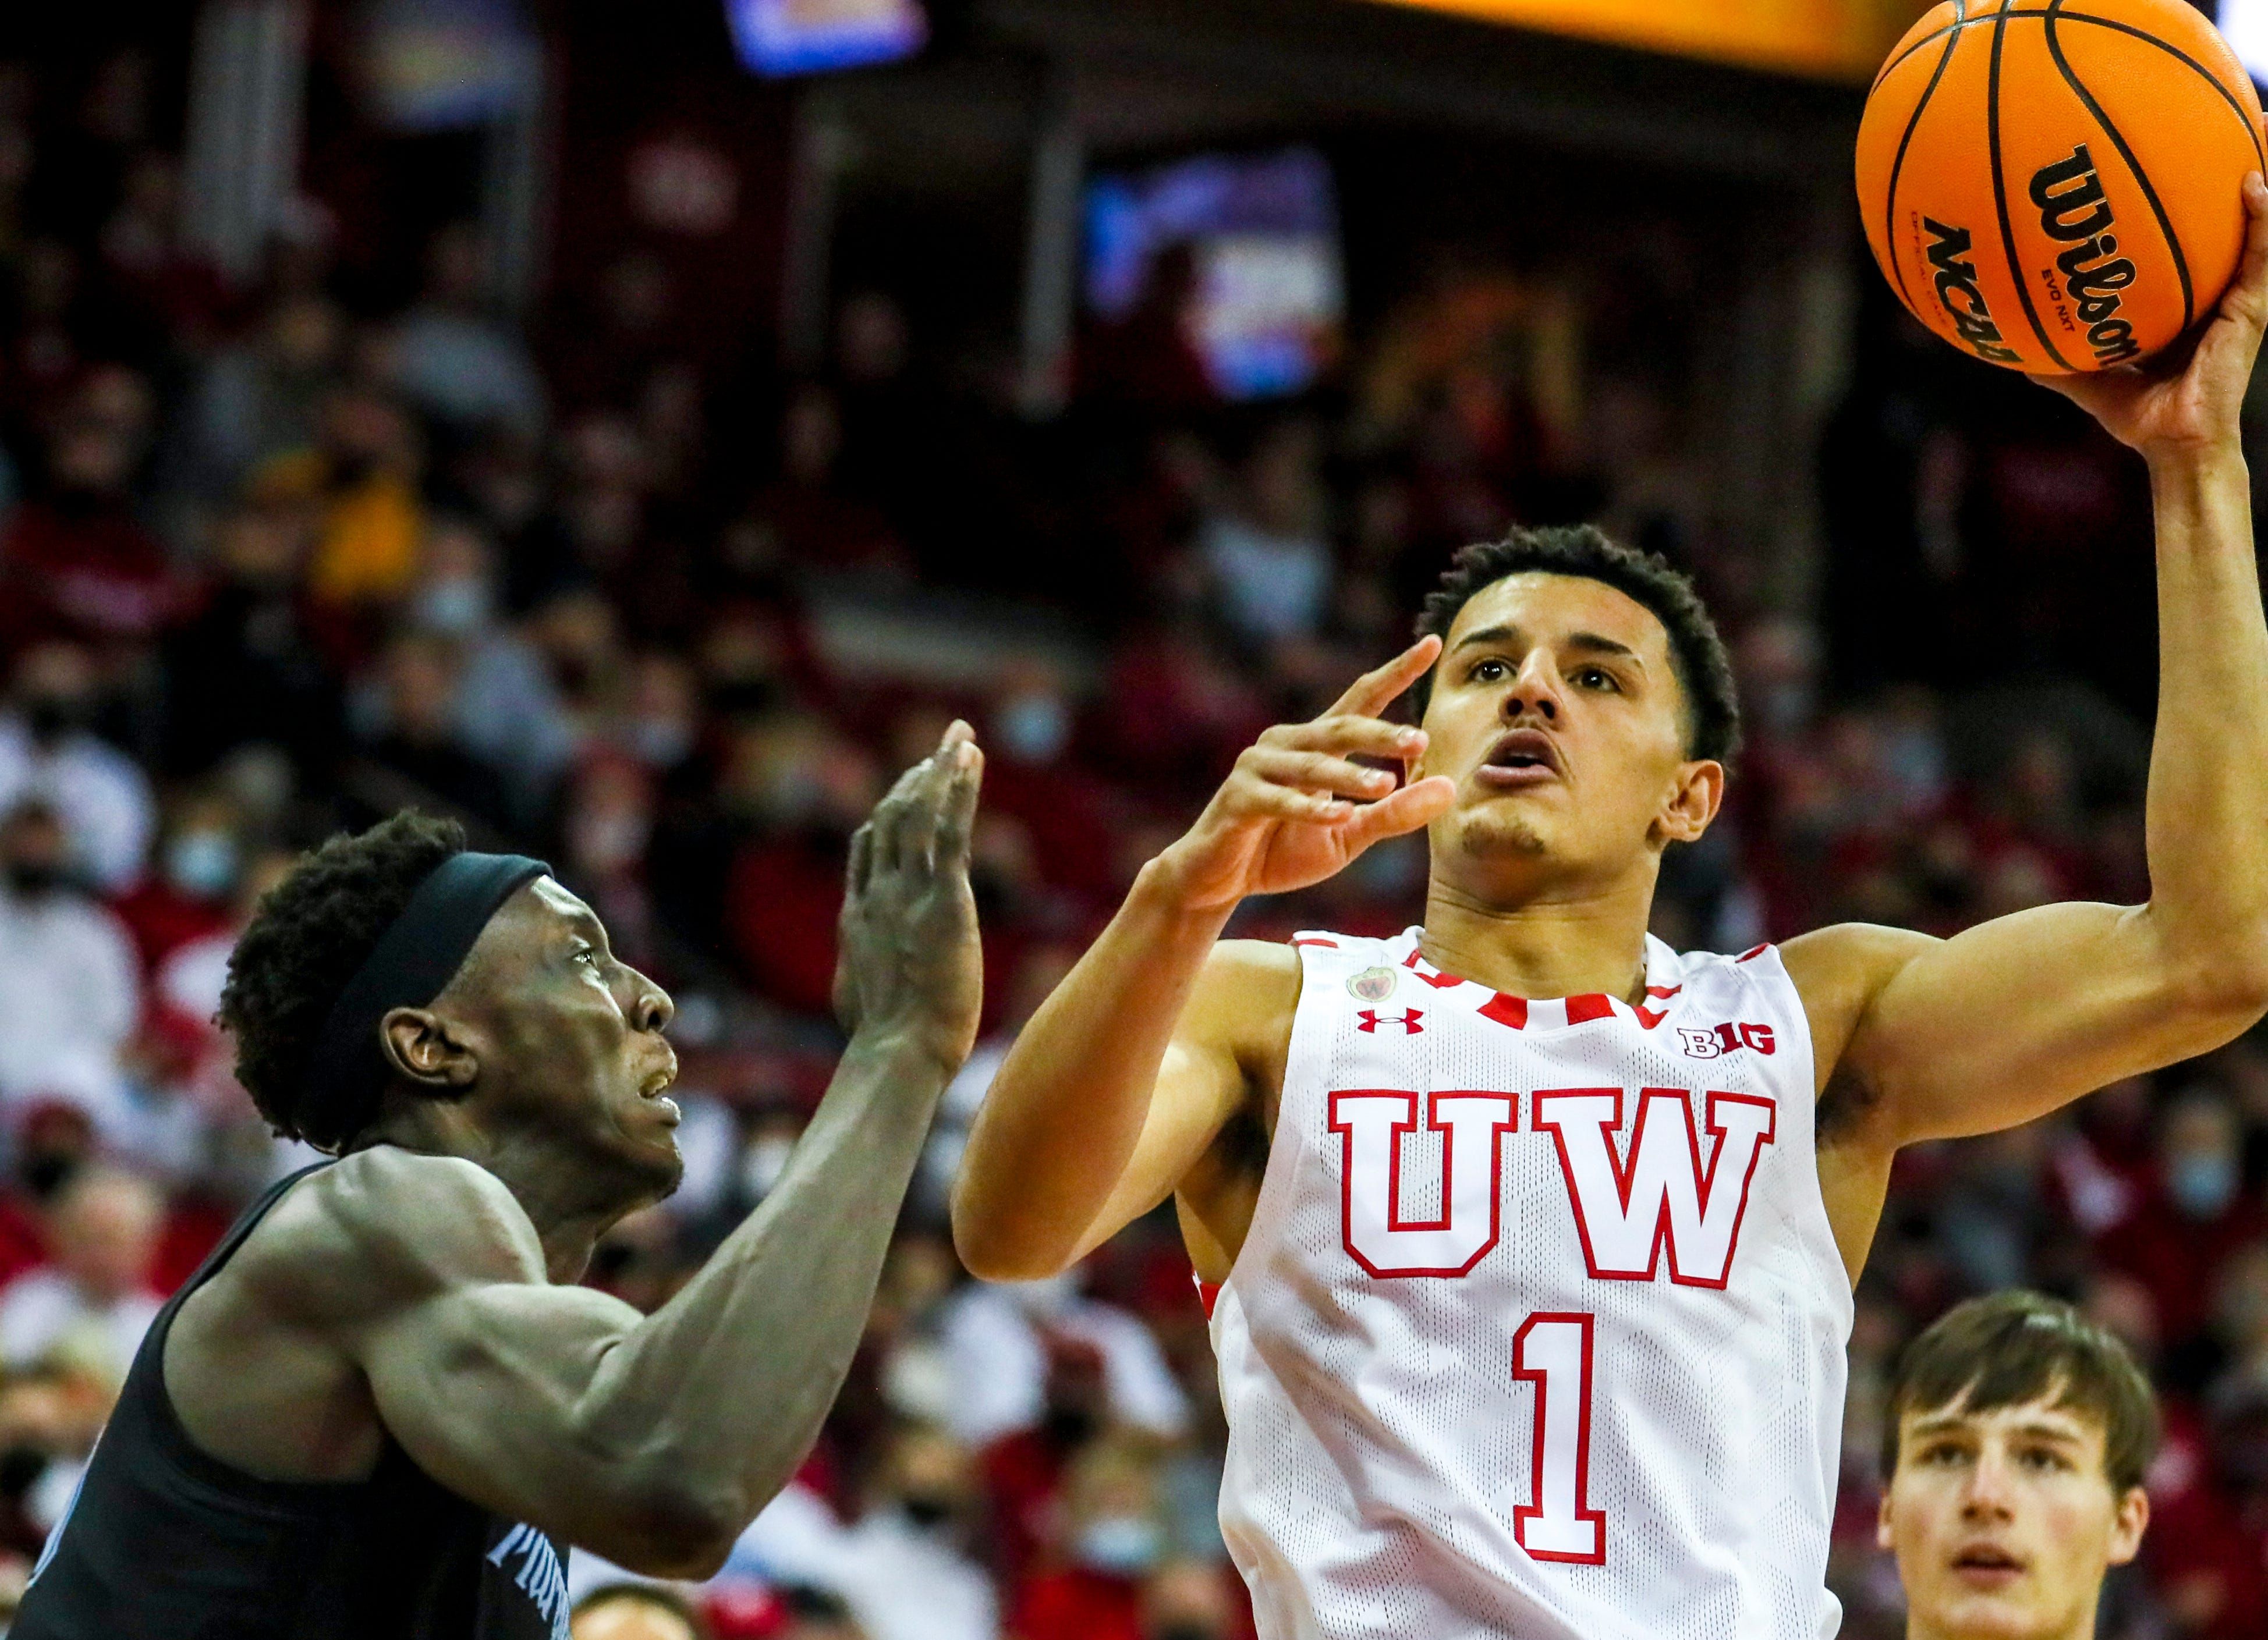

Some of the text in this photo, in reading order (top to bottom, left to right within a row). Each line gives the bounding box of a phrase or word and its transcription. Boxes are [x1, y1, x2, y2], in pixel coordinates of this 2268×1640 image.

[1923, 215, 2025, 363] NCAA
[2029, 143, 2141, 367] Wilson
[2041, 268, 2075, 332] EVO NXT
[1328, 1087, 1777, 1290] UW
[1512, 1311, 1606, 1566] 1
